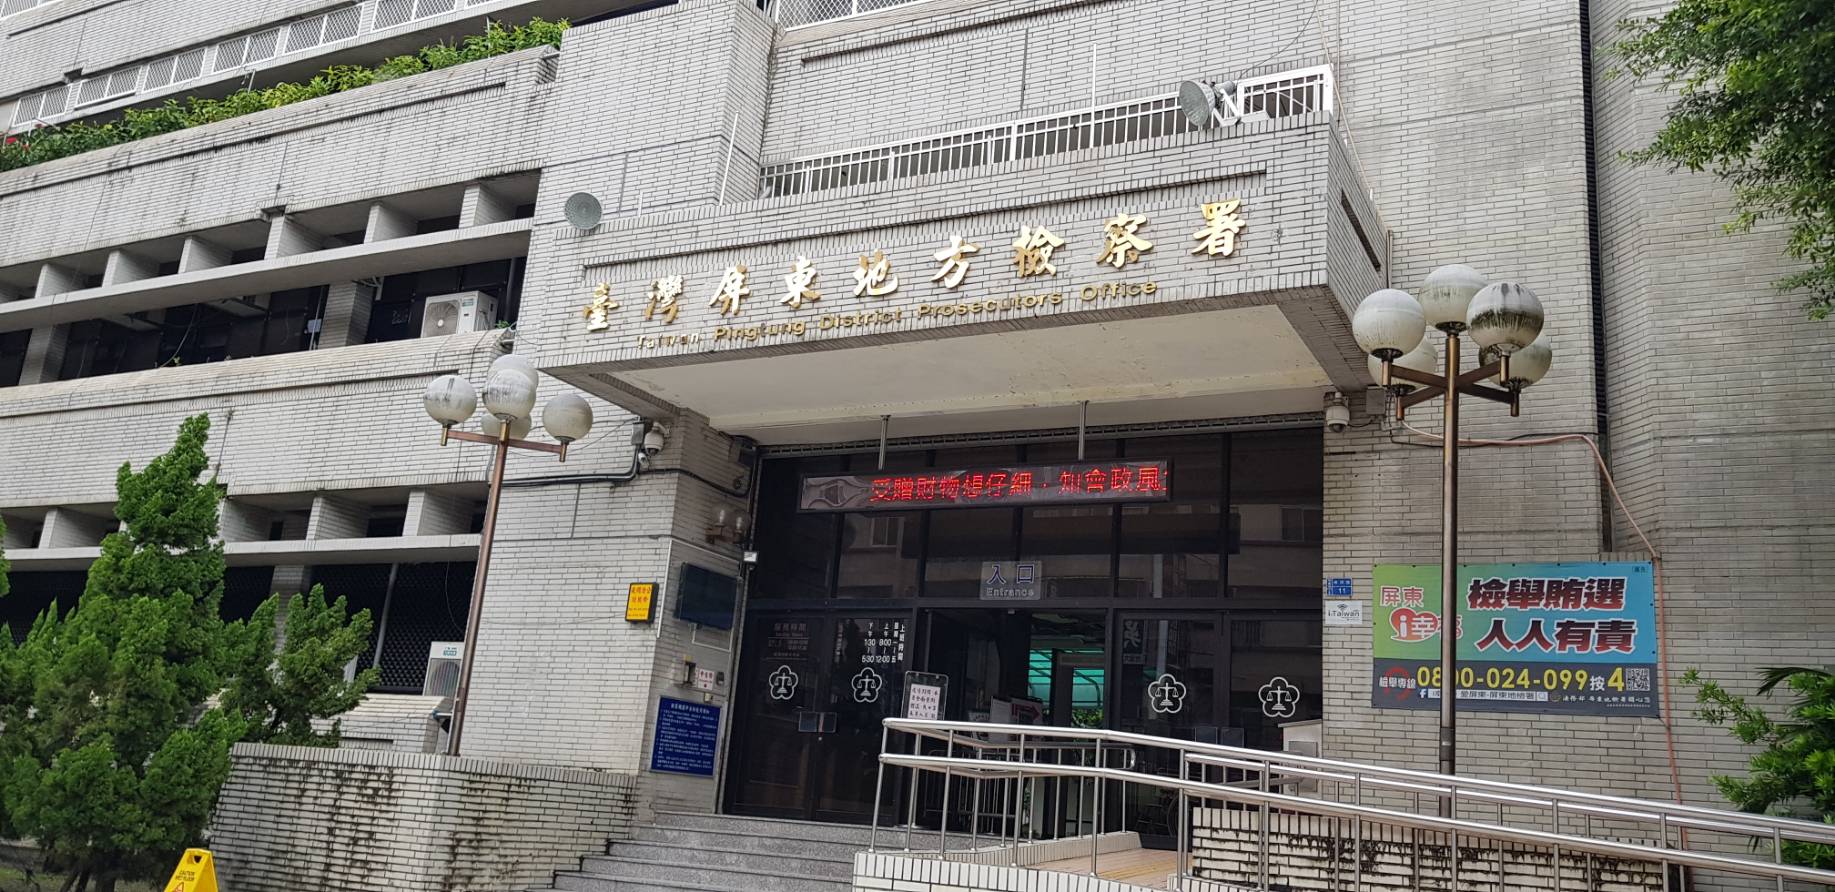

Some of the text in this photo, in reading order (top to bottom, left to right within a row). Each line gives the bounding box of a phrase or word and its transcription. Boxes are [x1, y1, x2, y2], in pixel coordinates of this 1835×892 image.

[583, 199, 1247, 332] 臺灣屏東地方檢察署
[637, 279, 1158, 349] Taiwan Pingtung District Prosecutors Office
[986, 564, 1035, 584] 入口
[986, 587, 1035, 597] Entrance
[1380, 586, 1424, 607] 屏東
[1467, 576, 1628, 612] 檢舉賄選
[1474, 617, 1637, 654] 人人有責
[1416, 665, 1588, 690] 080-024-099
